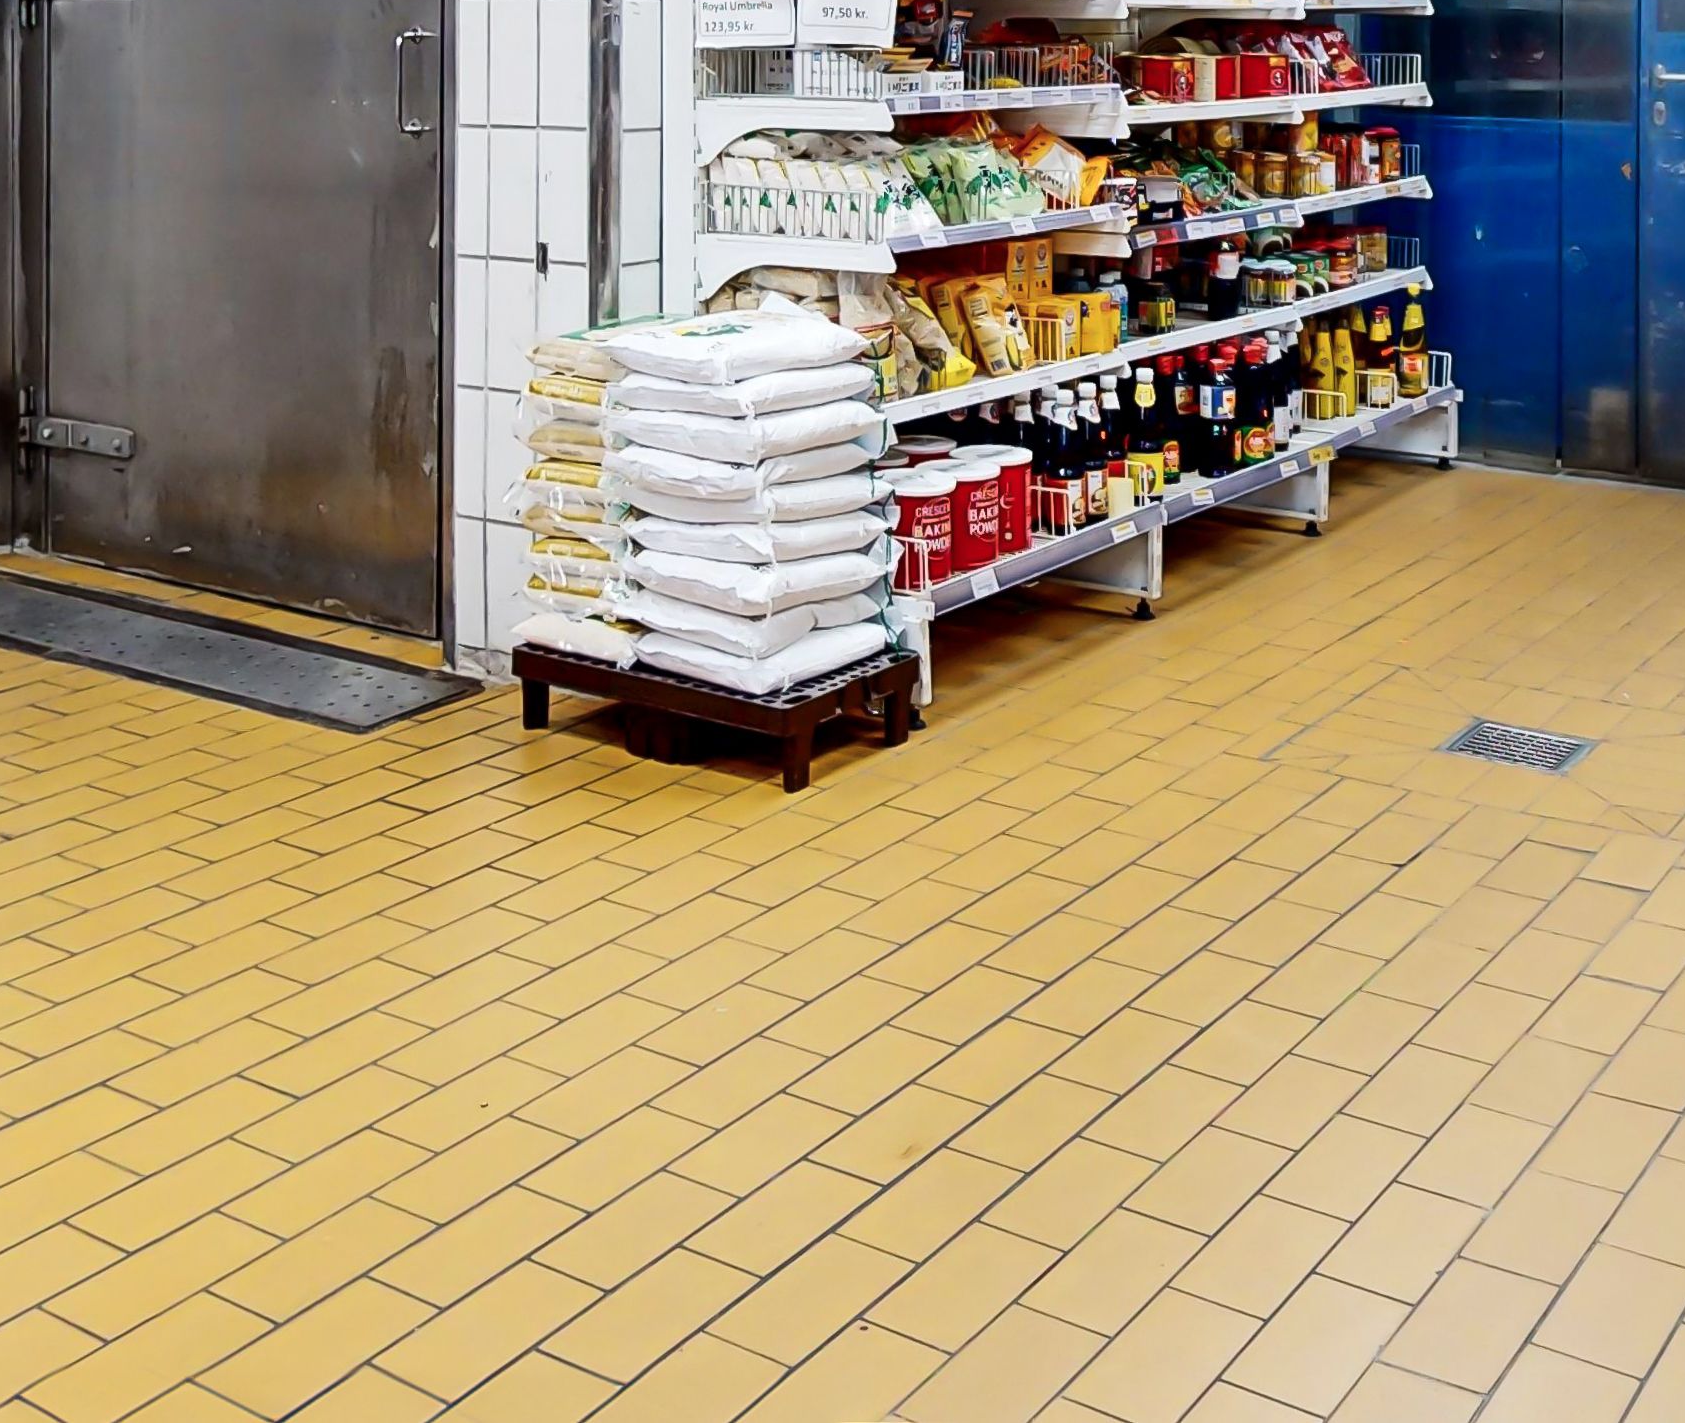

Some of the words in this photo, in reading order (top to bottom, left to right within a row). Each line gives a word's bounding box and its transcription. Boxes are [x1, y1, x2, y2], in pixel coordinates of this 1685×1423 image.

[702, 2, 728, 13] Royal
[822, 7, 852, 19] 97,50
[705, 21, 741, 34] 123,95
